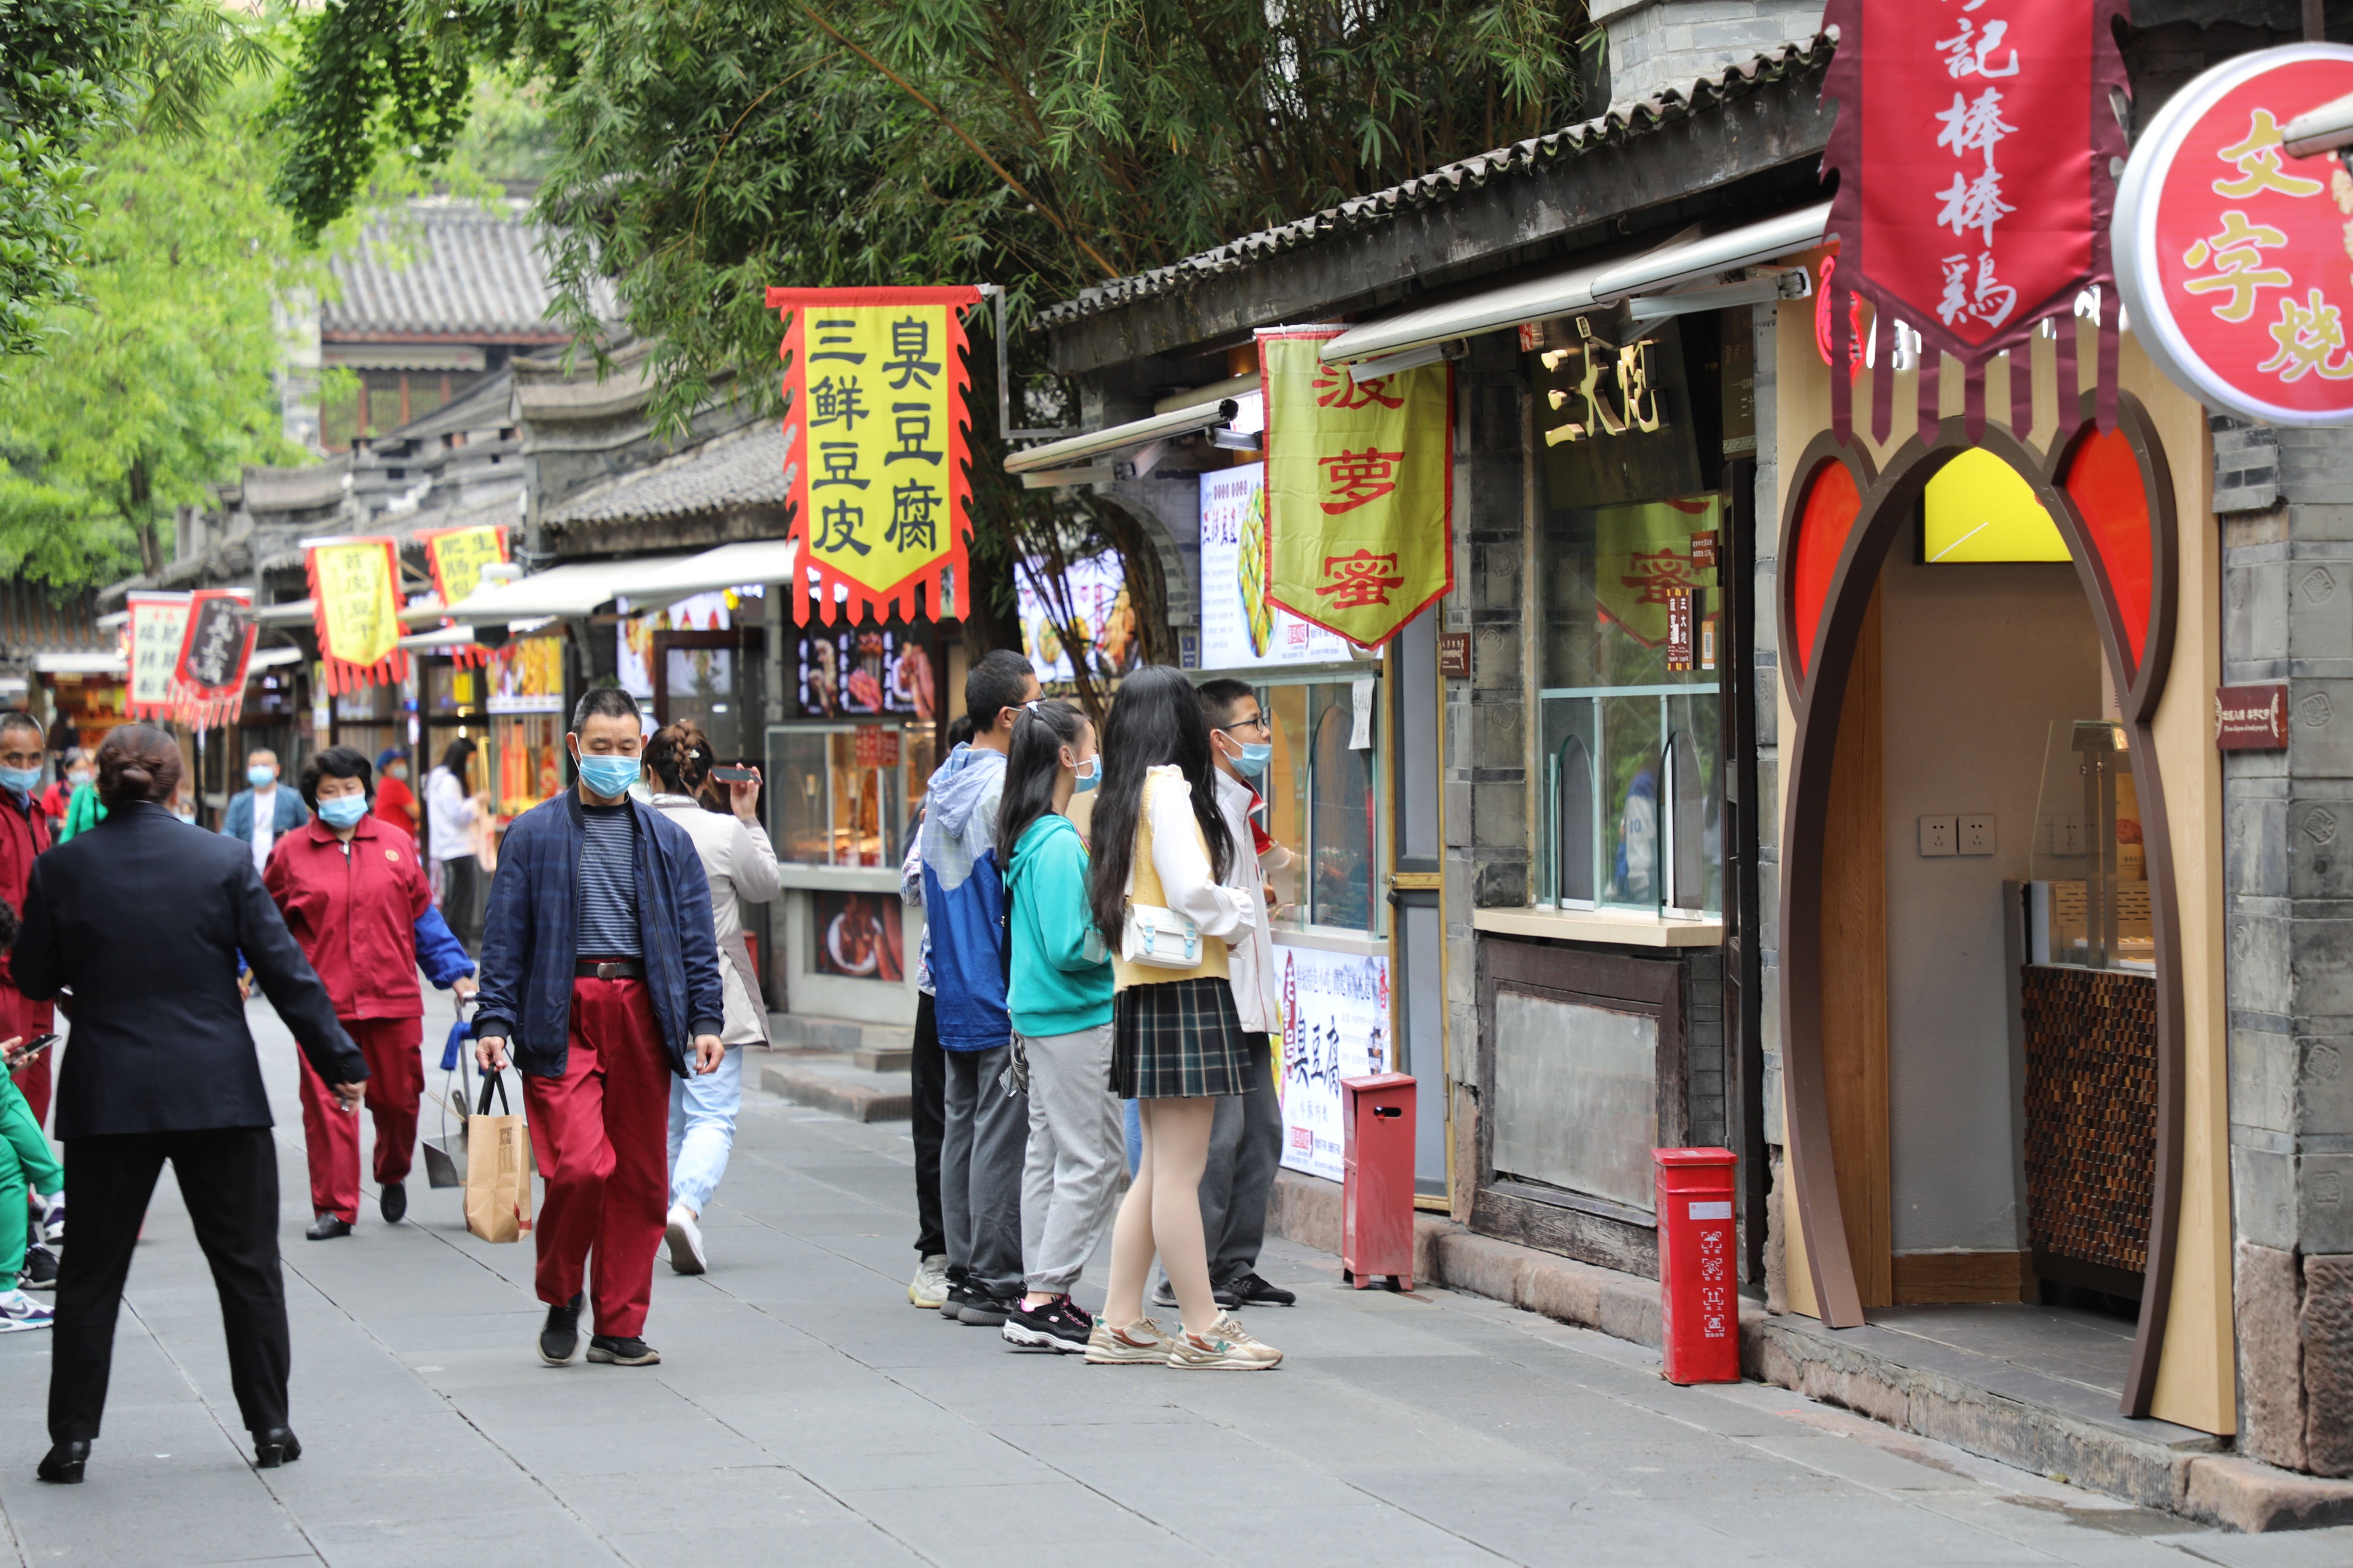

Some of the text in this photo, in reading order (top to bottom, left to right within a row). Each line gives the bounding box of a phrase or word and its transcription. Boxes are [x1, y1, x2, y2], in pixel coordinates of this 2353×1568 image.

[809, 320, 872, 556] 三鲜豆皮
[882, 315, 943, 553] 臭豆腐
[1294, 1007, 1340, 1099] 臭豆腐
